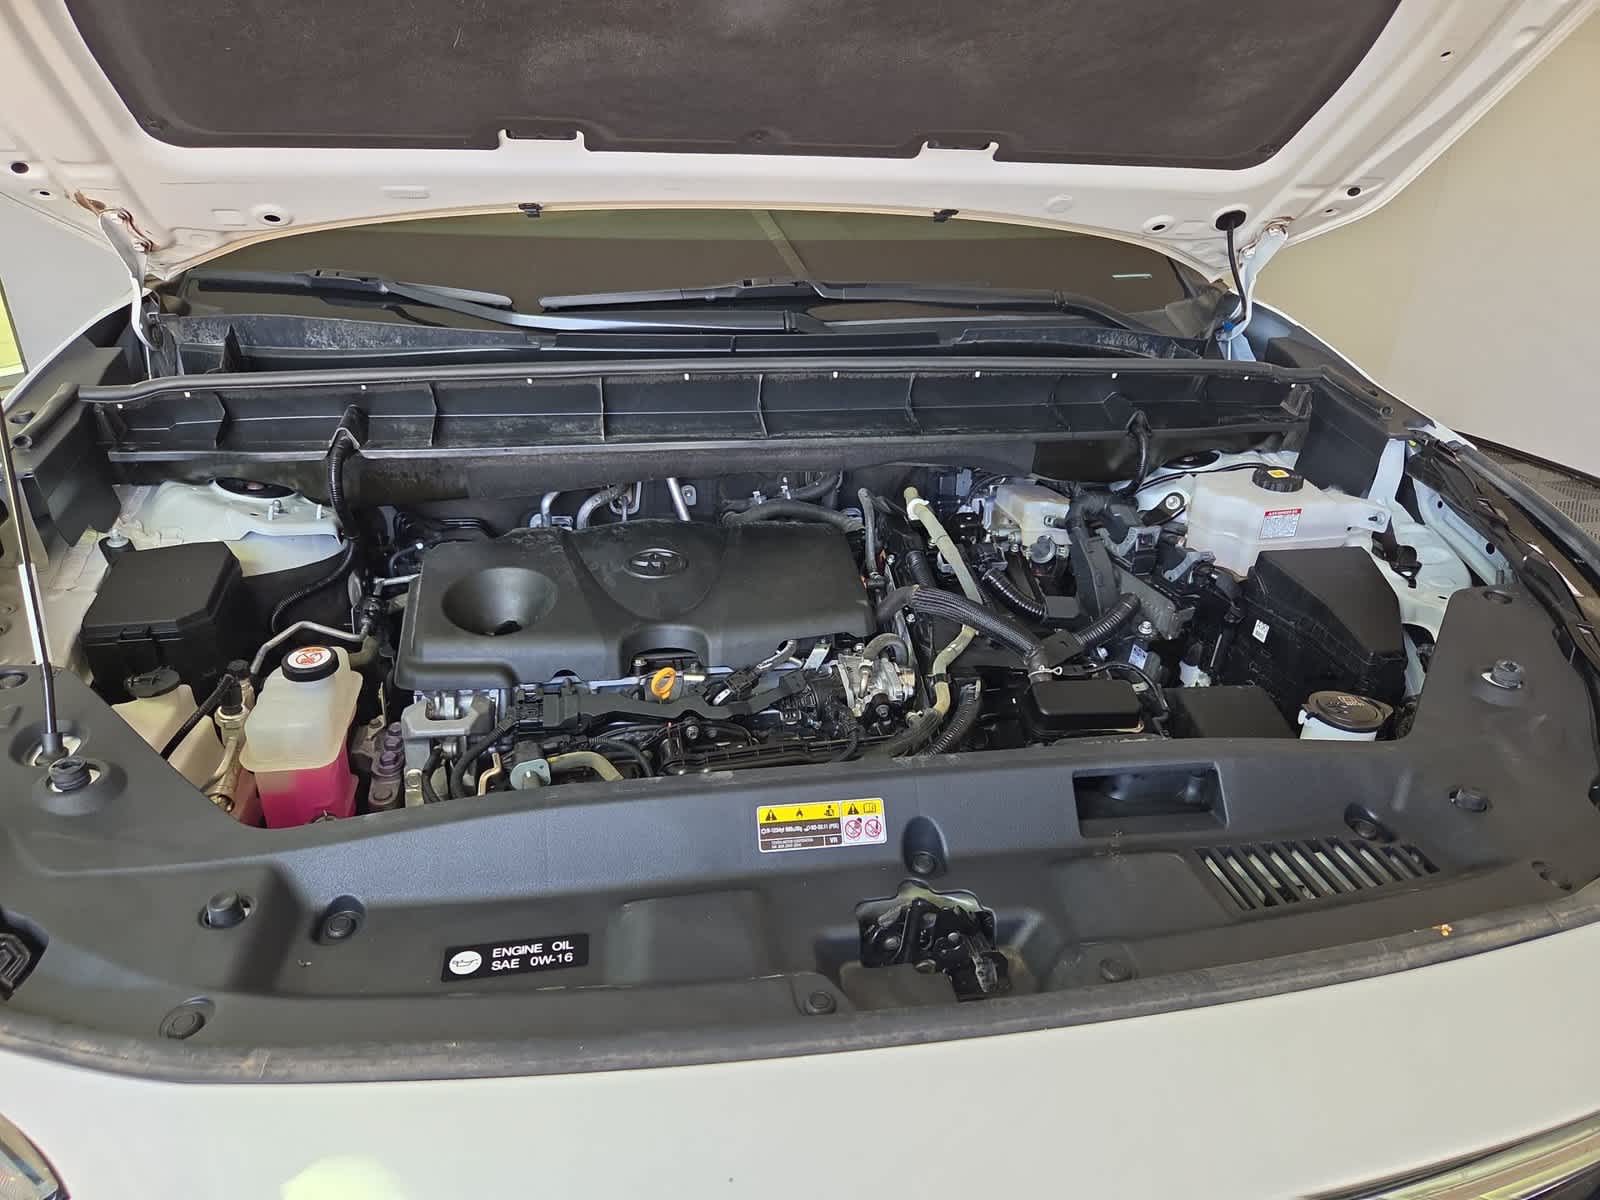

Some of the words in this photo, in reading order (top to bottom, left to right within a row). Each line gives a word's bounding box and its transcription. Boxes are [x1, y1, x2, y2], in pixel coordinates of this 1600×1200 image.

[492, 943, 543, 958] ENGINE
[552, 941, 574, 951] OIL
[491, 958, 520, 971] SAE
[530, 952, 573, 966] 0W-16
